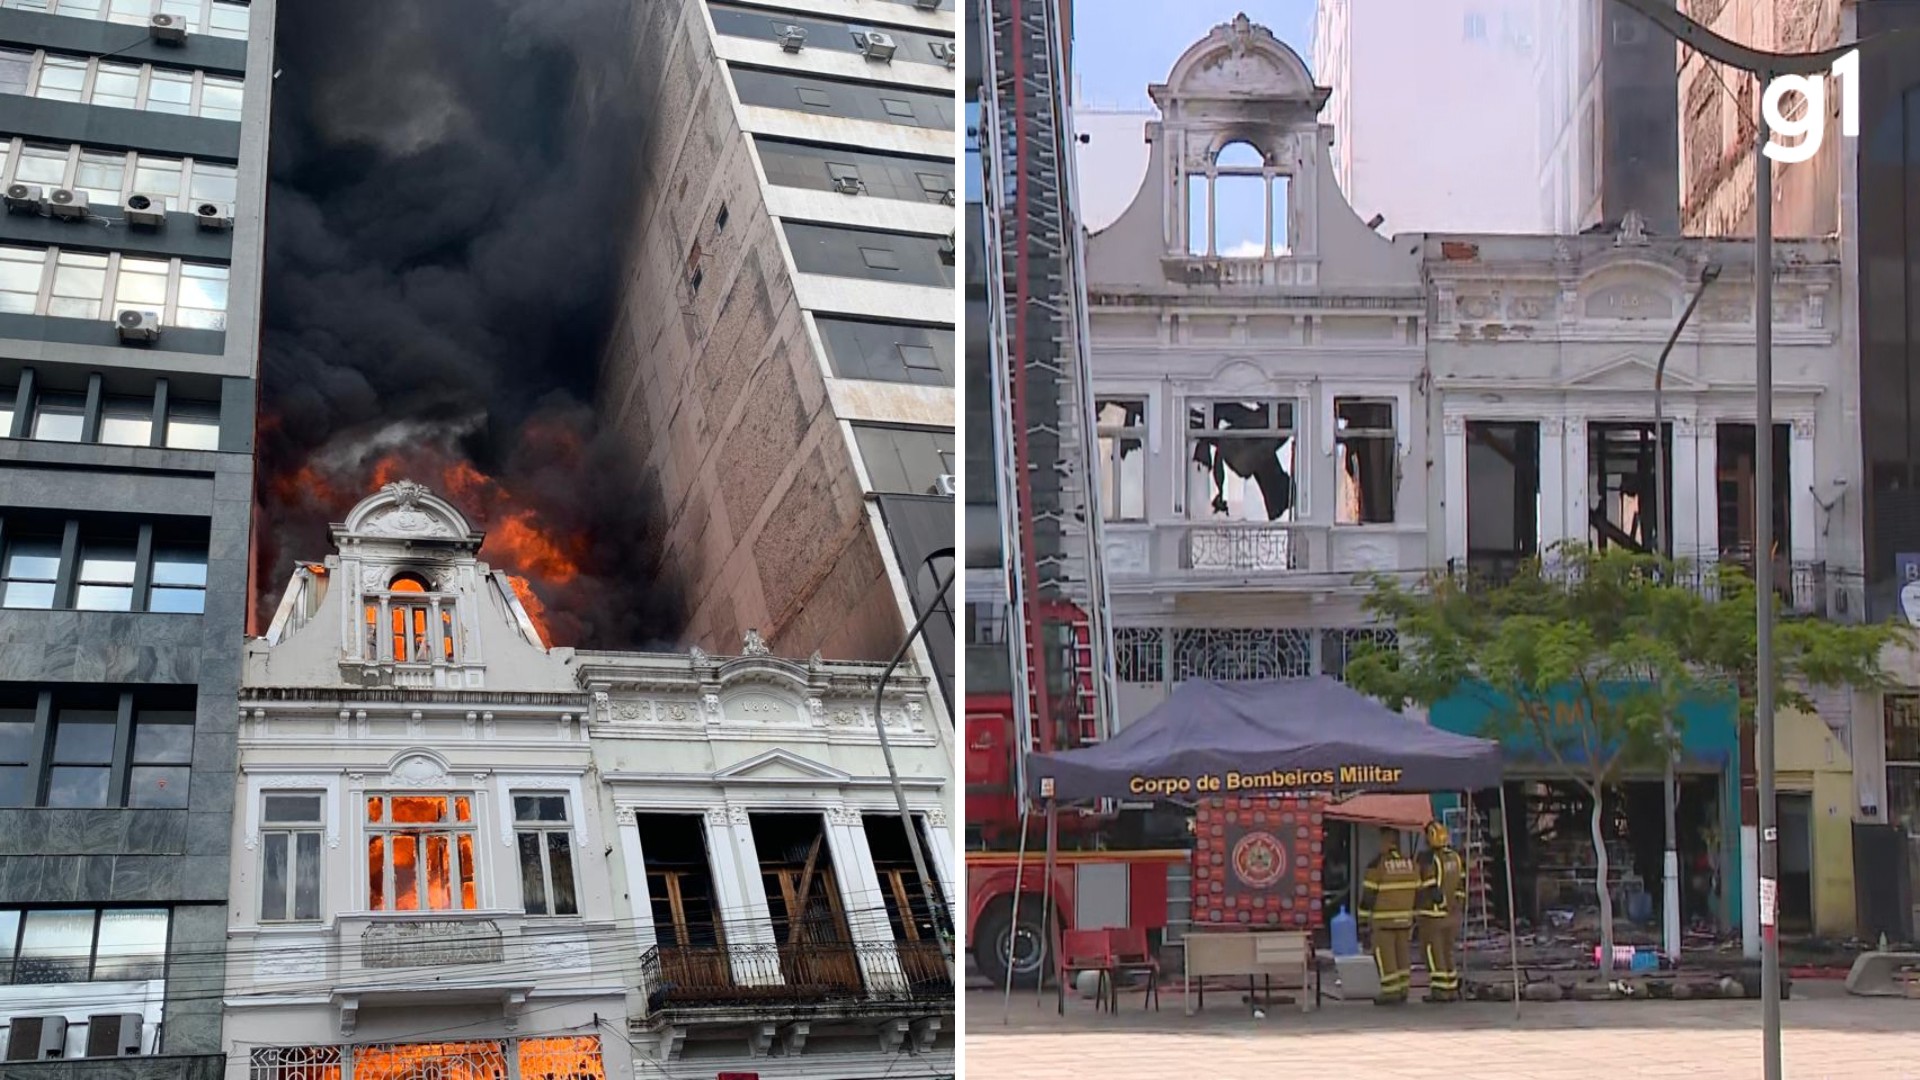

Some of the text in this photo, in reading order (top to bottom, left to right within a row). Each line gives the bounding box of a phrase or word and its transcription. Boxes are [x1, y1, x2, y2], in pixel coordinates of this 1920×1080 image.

[1129, 764, 1403, 796] Corpo de Bombeiros Militar
